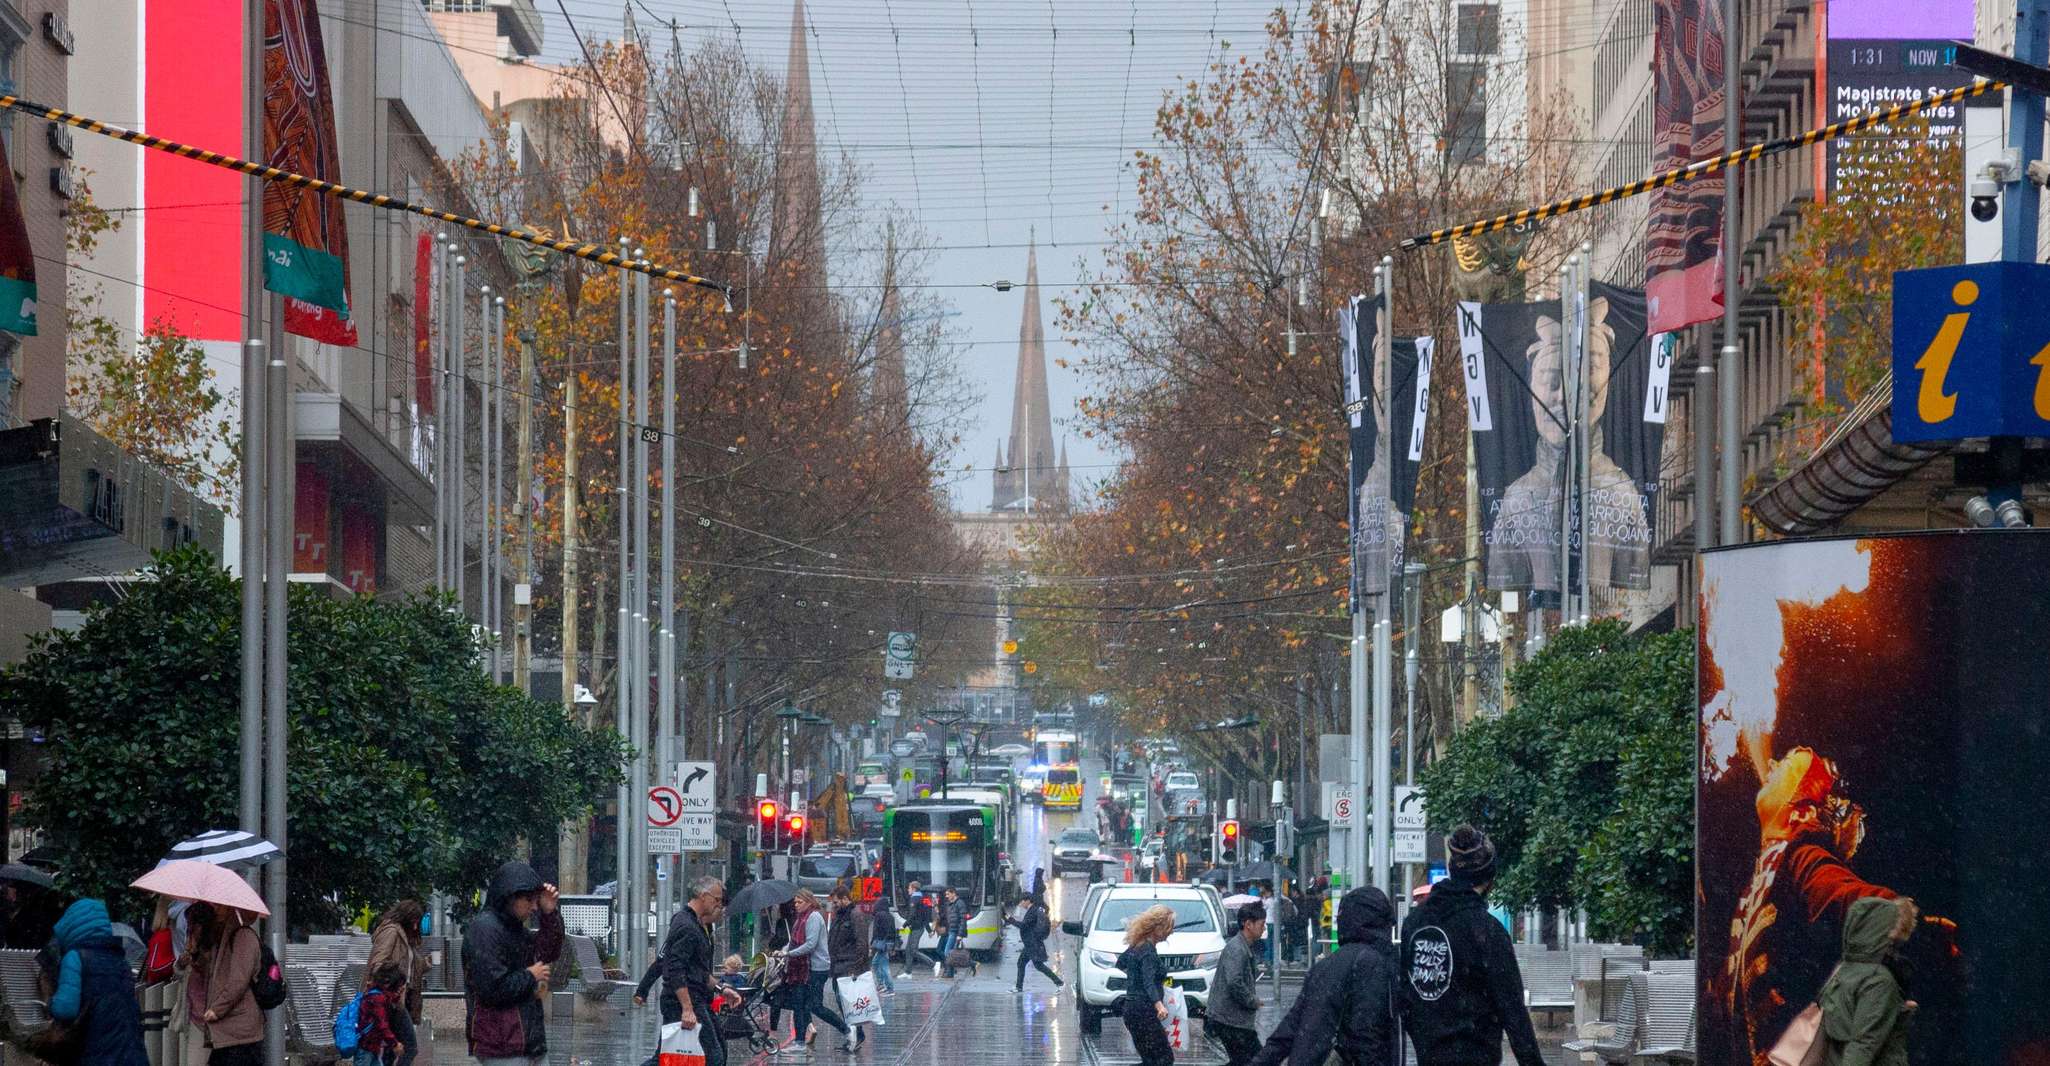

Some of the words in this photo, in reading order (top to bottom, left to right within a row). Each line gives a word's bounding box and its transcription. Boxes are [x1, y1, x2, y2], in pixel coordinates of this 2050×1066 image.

[1851, 48, 1882, 65] 1:31
[1909, 49, 1937, 65] NOW
[1837, 86, 1922, 103] Magistrate
[1347, 402, 1364, 415] 38
[643, 429, 660, 442] 38
[697, 516, 711, 528] 39
[682, 798, 709, 808] ONLY
[1397, 816, 1423, 825] ONLY
[1414, 940, 1447, 956] SNAKE
